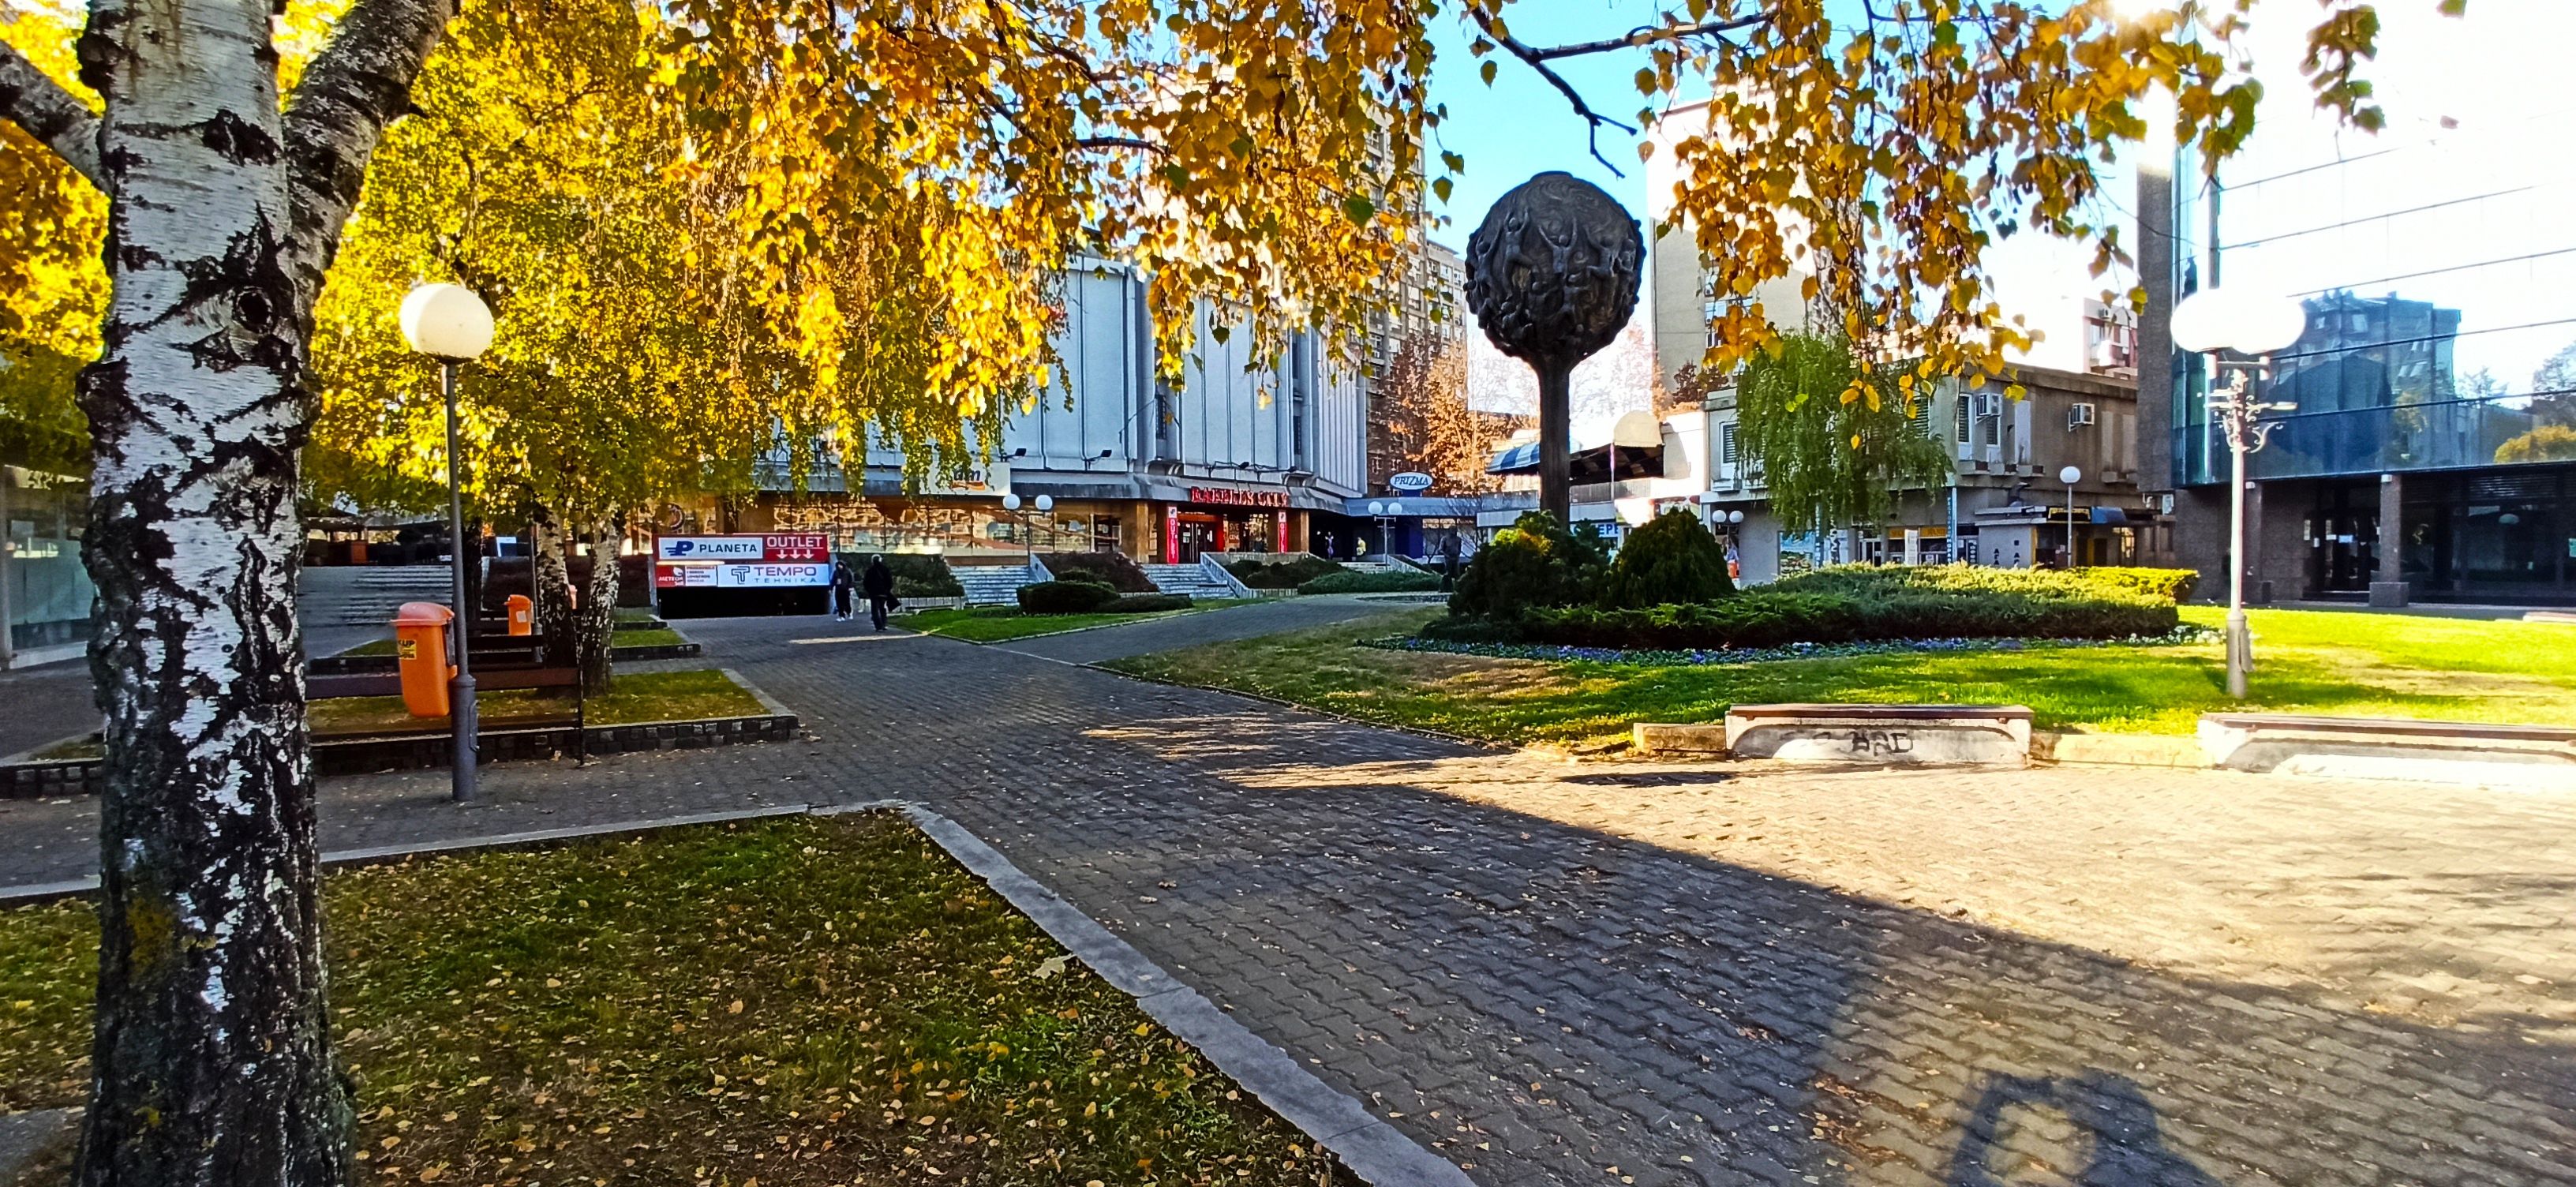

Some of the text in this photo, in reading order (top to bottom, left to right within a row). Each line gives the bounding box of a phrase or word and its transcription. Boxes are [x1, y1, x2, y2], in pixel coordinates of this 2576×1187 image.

[1393, 475, 1429, 486] PRIZMA
[766, 536, 822, 548] OUTLET
[699, 544, 758, 552] PLANETA
[754, 567, 817, 576] TEMPO
